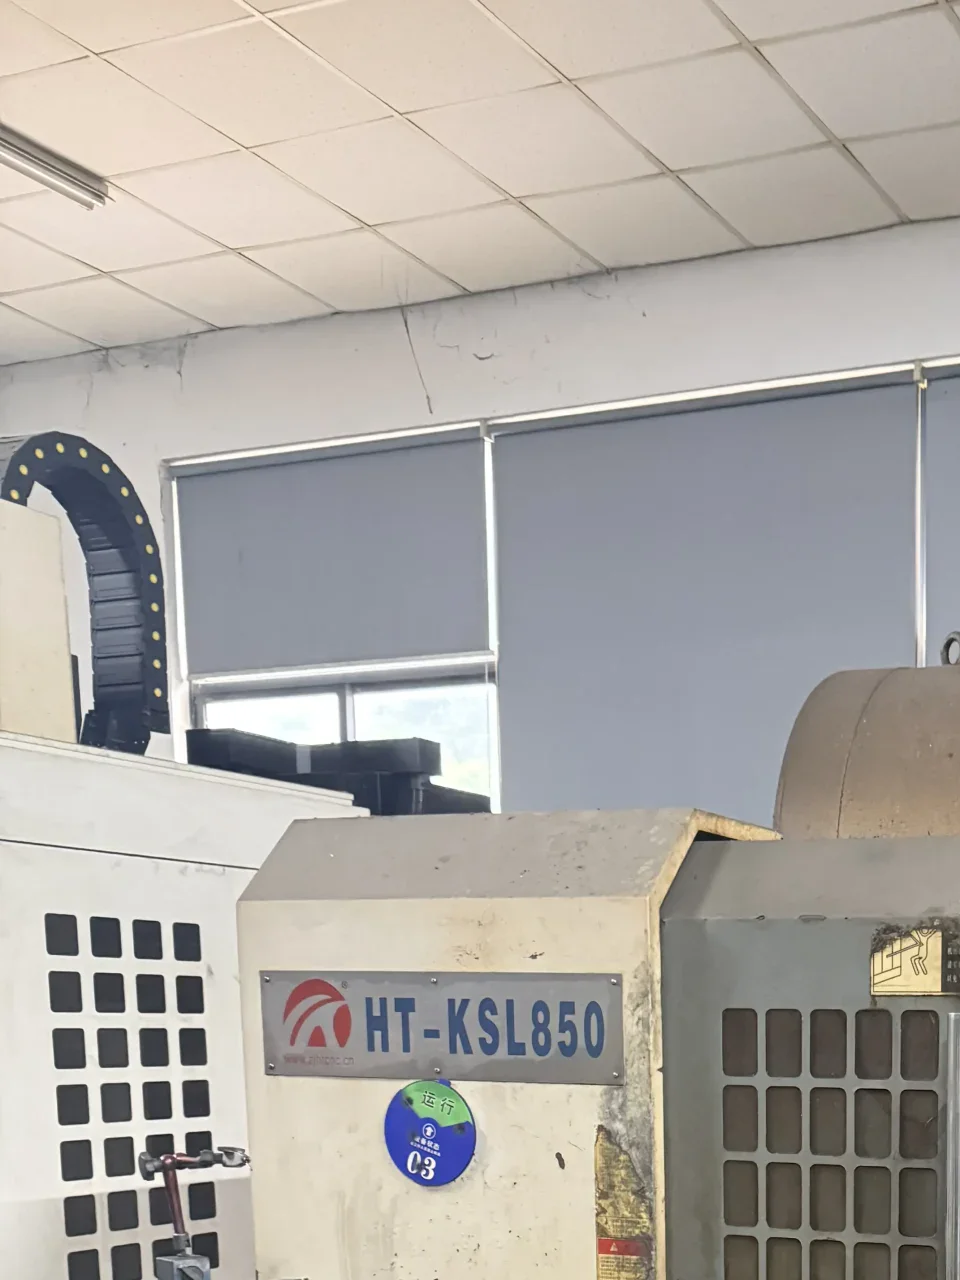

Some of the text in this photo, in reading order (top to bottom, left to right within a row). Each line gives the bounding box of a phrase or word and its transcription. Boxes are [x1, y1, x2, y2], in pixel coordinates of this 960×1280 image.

[365, 996, 605, 1058] HT-KSL850
[421, 1090, 455, 1115] 运行
[407, 1150, 436, 1180] 03
